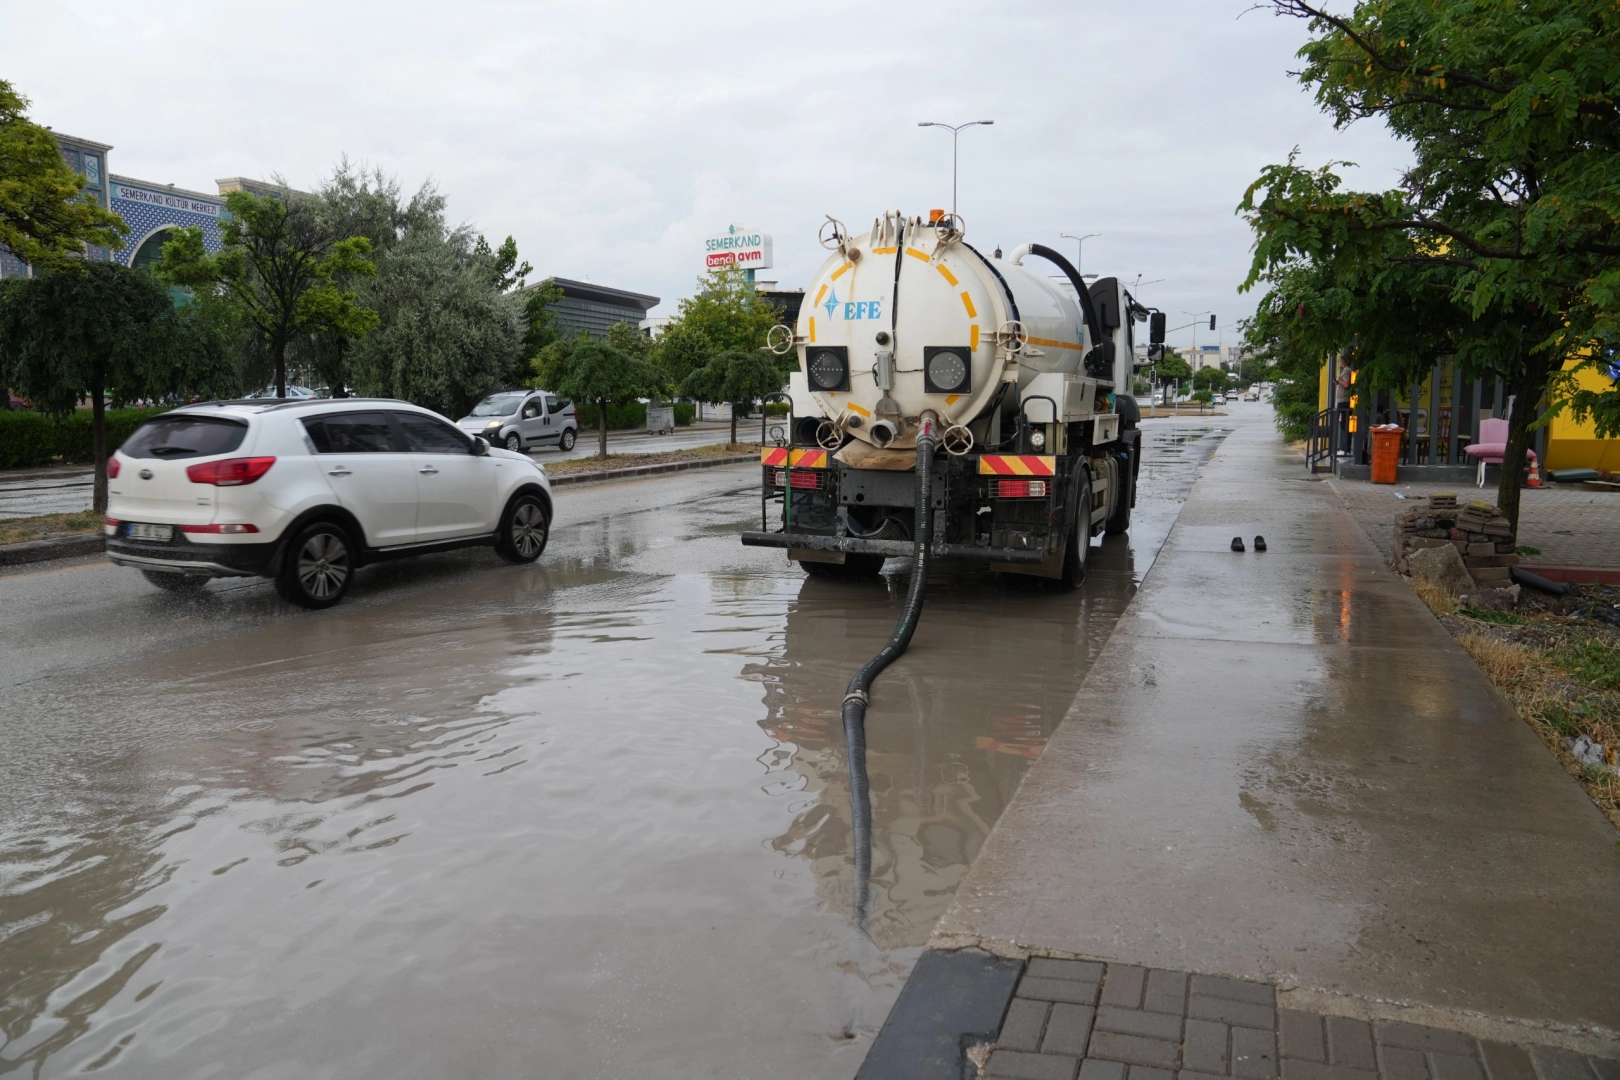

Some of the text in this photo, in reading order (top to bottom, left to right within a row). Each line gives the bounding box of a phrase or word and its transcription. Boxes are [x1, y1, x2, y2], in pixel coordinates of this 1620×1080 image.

[121, 188, 163, 204] SEMERKAND
[166, 197, 189, 209] KÜLTÜR
[706, 235, 760, 251] SEMERKAND
[738, 250, 761, 261] avm
[844, 301, 881, 320] EFE
